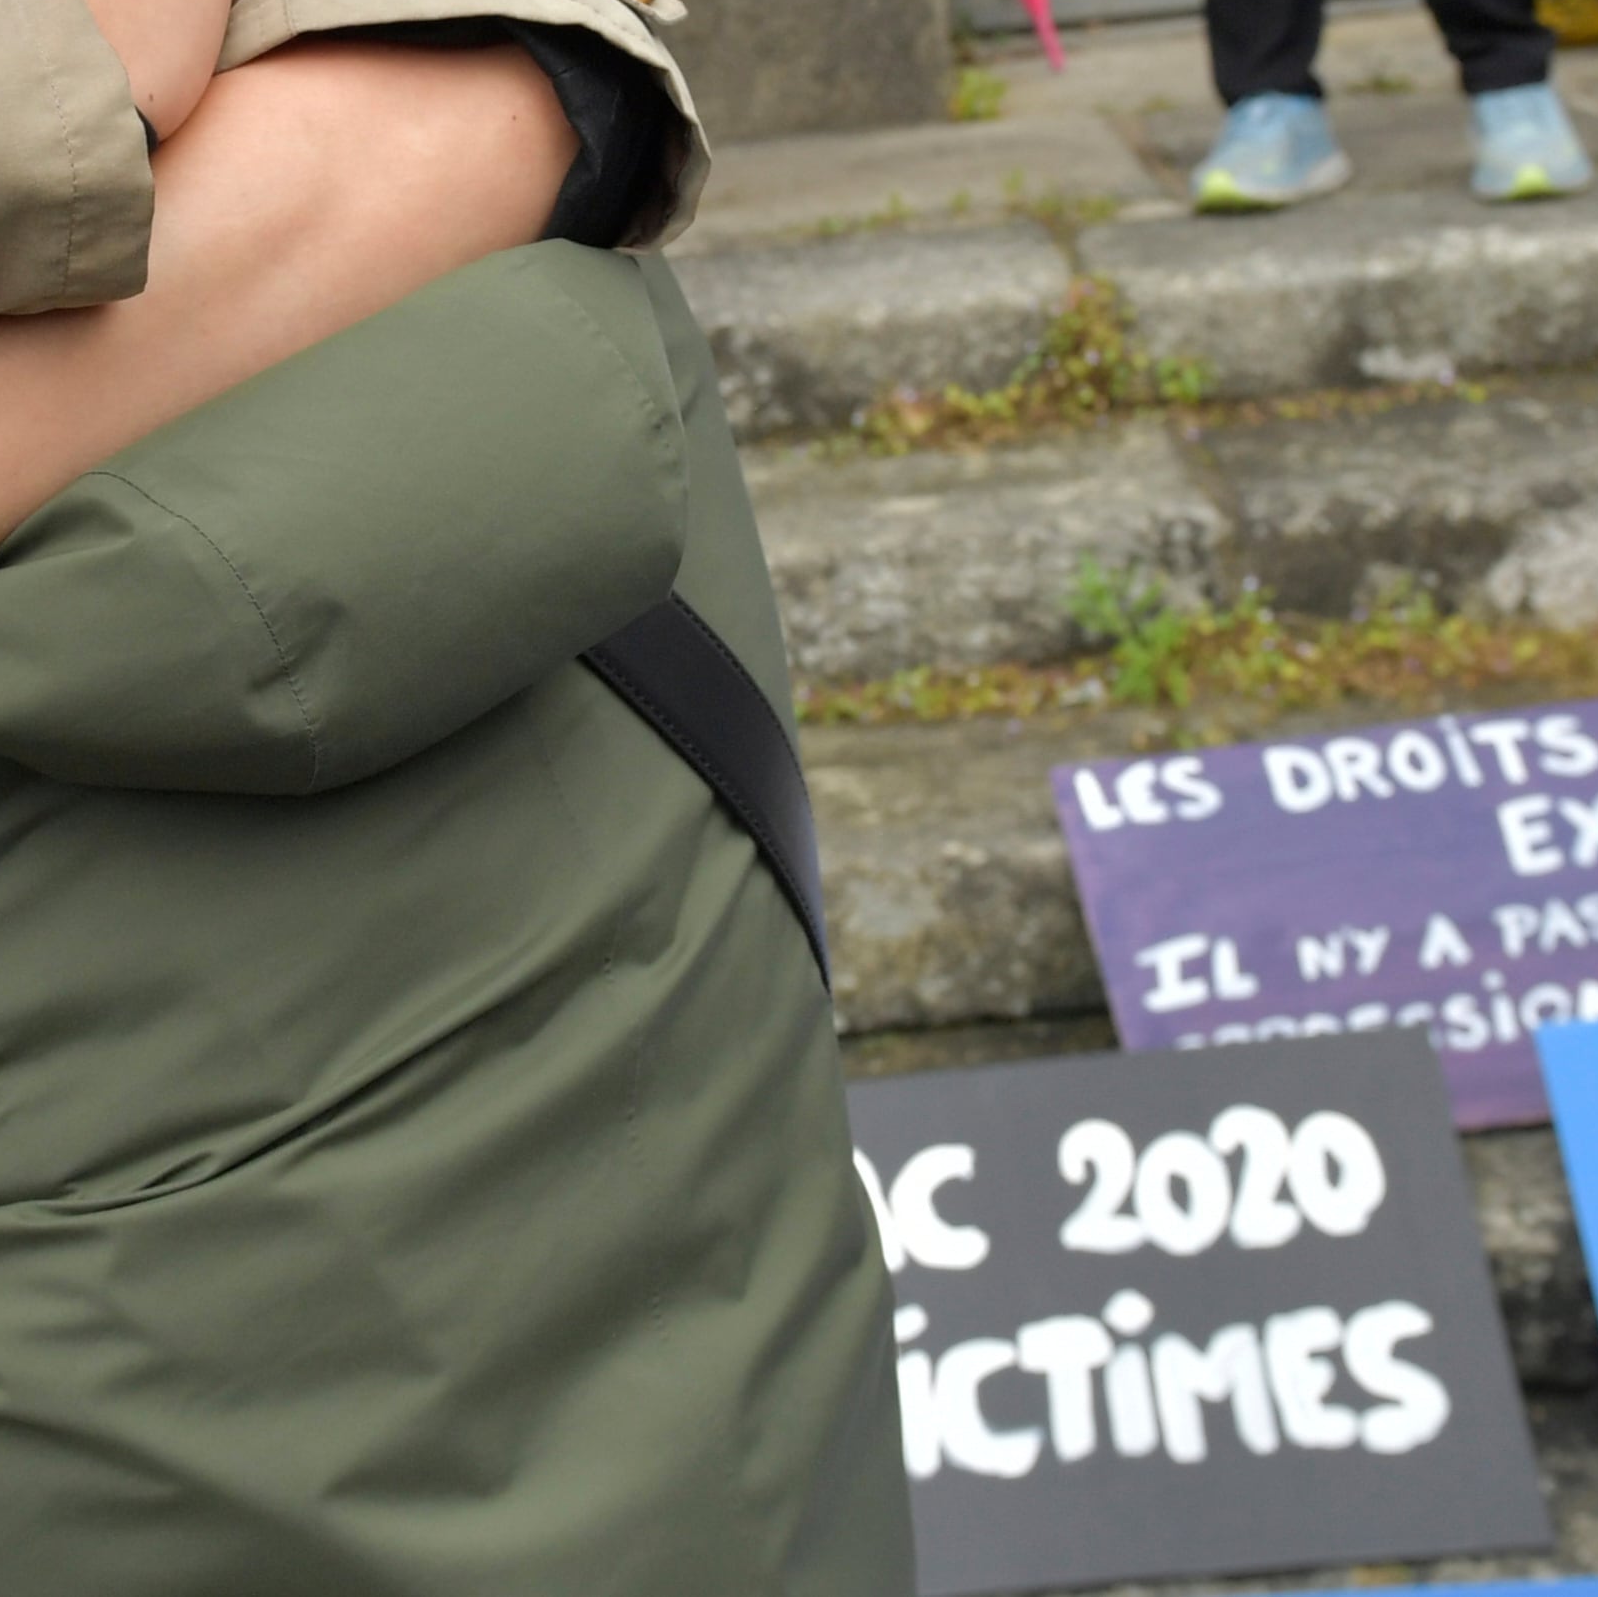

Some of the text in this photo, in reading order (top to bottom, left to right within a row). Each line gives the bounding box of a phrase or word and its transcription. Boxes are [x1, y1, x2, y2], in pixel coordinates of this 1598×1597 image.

[1073, 755, 1224, 831] LES
[1417, 911, 1474, 971] A
[851, 1102, 1388, 1273] C 2020
